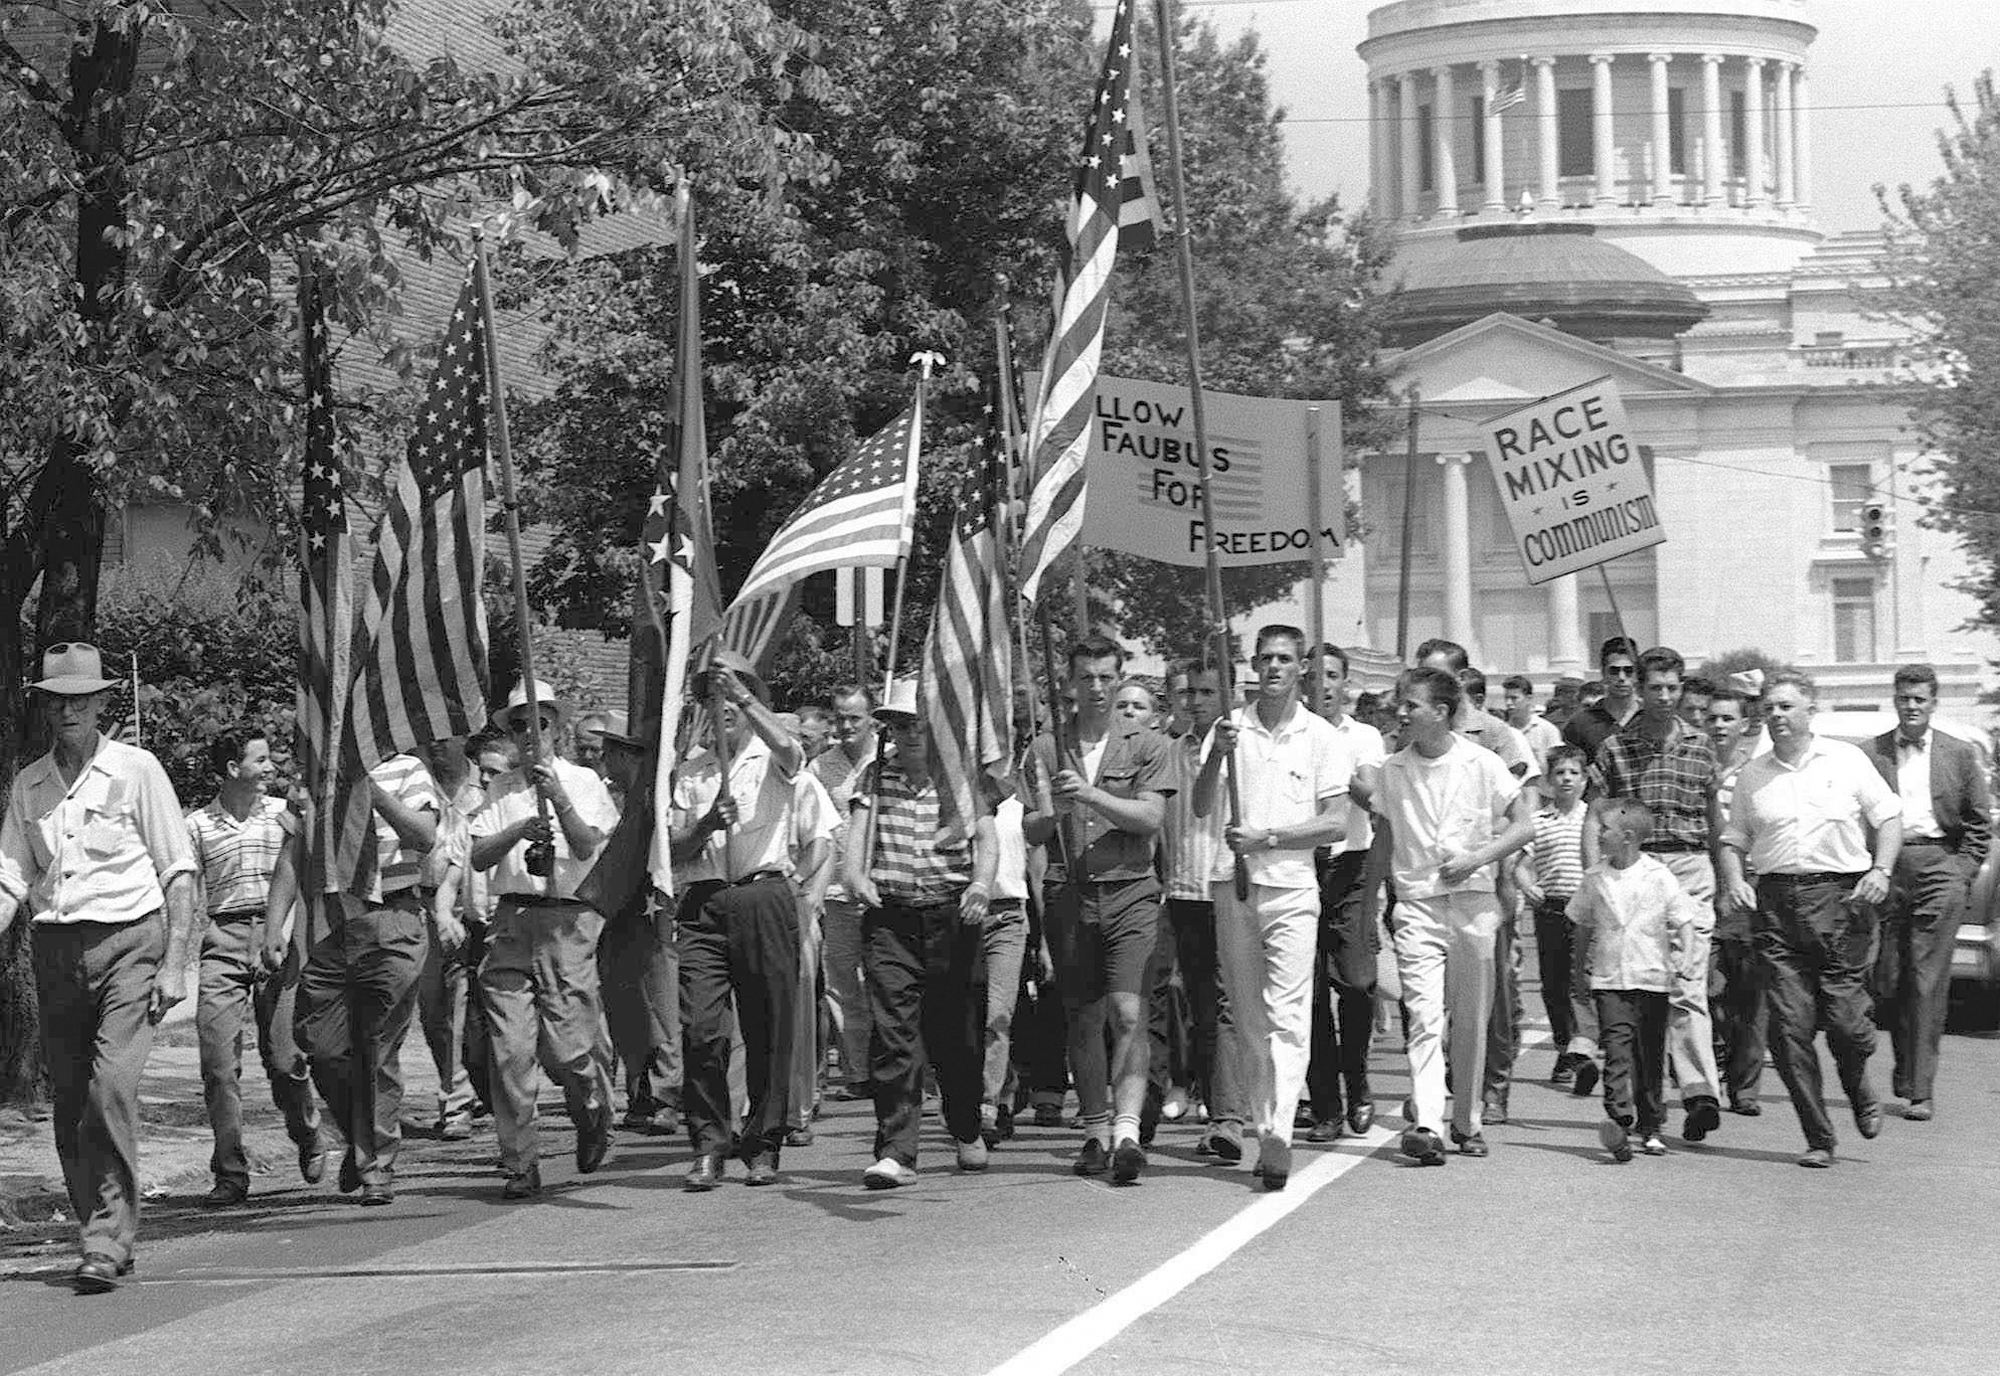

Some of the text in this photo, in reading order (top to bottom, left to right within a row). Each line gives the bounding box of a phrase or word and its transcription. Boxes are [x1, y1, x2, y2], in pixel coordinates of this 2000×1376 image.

[1494, 396, 1609, 461] RACE
[1504, 434, 1630, 501] MIXING
[1561, 490, 1590, 510] IS
